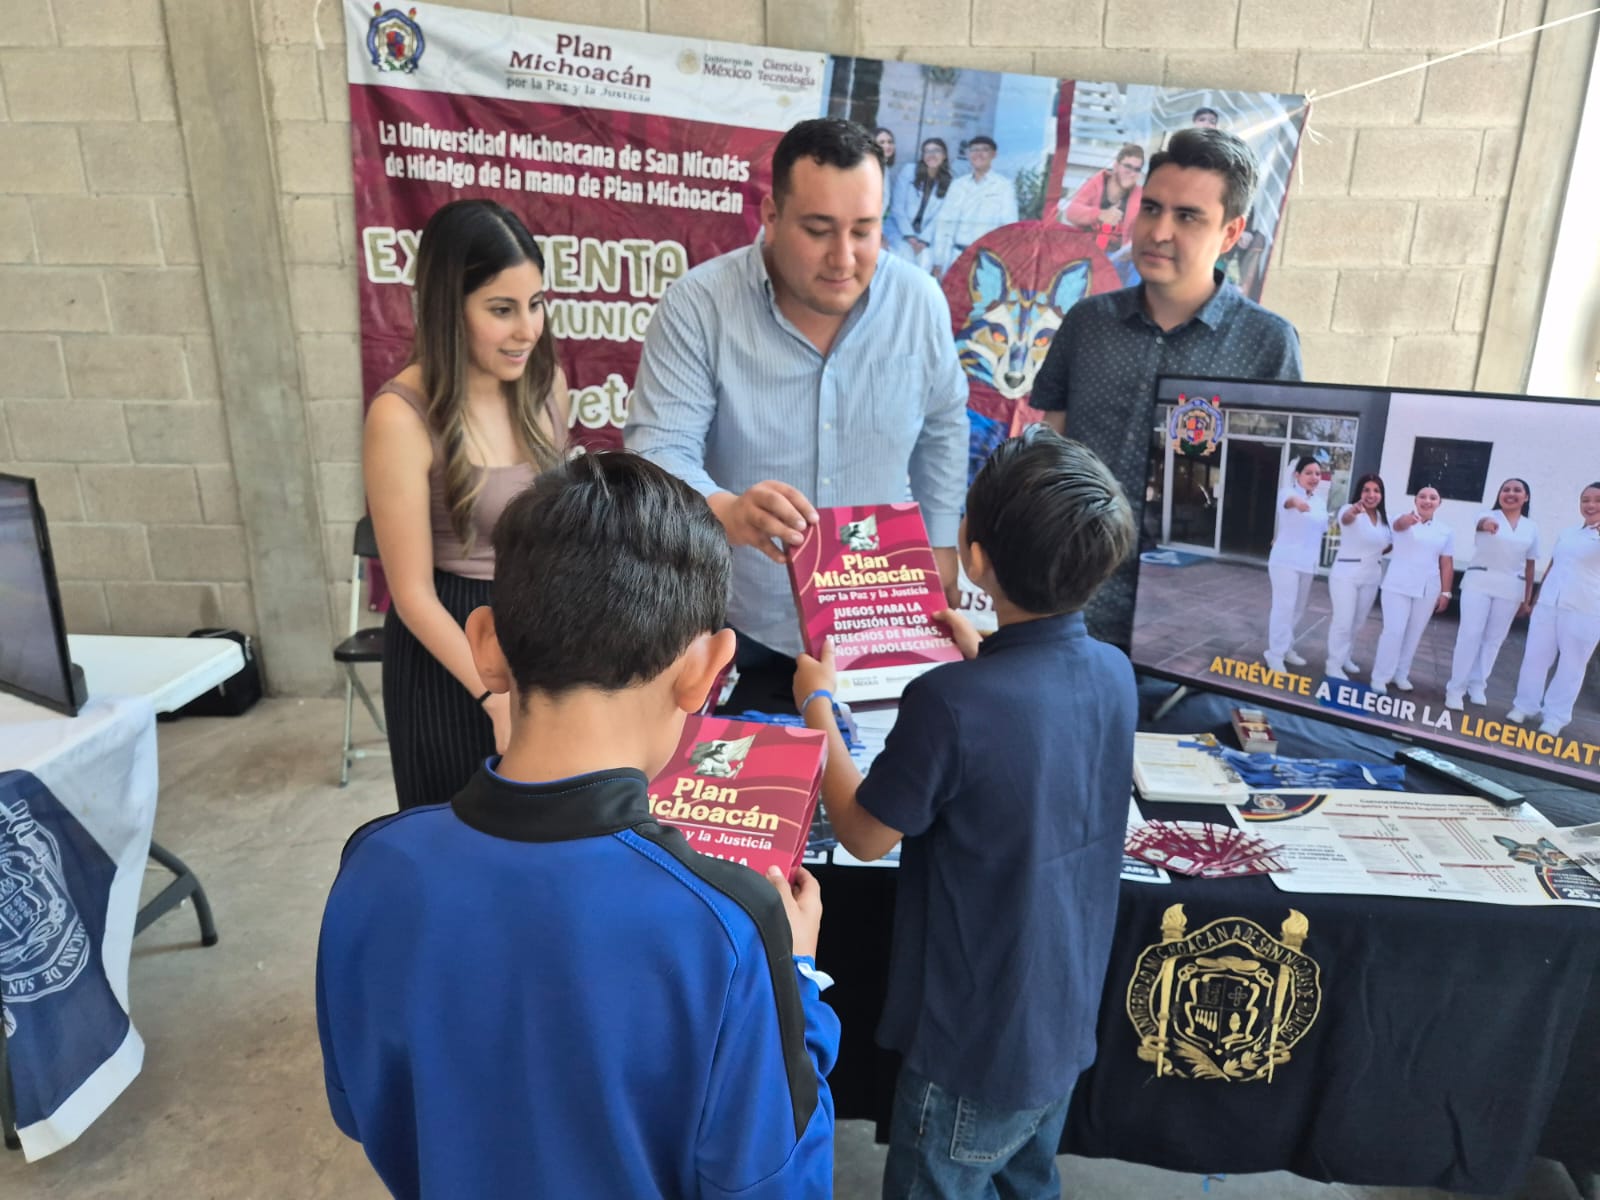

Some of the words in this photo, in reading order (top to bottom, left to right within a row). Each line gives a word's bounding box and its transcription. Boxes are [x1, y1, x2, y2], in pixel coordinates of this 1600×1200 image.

[556, 33, 612, 61] Plan
[509, 50, 651, 89] Michoacán
[703, 63, 752, 80] México
[762, 58, 803, 72] Ciencia
[804, 64, 812, 75] y
[757, 70, 816, 86] Tecnología
[506, 76, 527, 89] por
[531, 77, 542, 90] la
[547, 79, 568, 92] Paz
[572, 84, 581, 95] y
[585, 84, 596, 95] la
[600, 86, 651, 102] Justicia
[378, 120, 397, 145] La
[399, 121, 506, 157] Universidad
[510, 133, 615, 168] Michoacana
[618, 144, 642, 171] de
[645, 147, 678, 175] San
[682, 150, 750, 182] Nicolás
[385, 151, 405, 177] de
[406, 154, 475, 189] Hidalgo
[478, 160, 501, 188] de
[504, 163, 521, 190] la
[524, 169, 575, 197] mano
[578, 172, 600, 198] de
[604, 175, 643, 203] Plan
[647, 180, 744, 214] Michoacán
[841, 553, 889, 570] Plan
[813, 564, 925, 588] Michoacán
[818, 594, 836, 604] por
[838, 591, 848, 601] la
[850, 591, 868, 601] Paz
[869, 591, 877, 601] y
[878, 589, 889, 598] la
[891, 586, 929, 598] Justicia
[834, 605, 875, 619] JUEGOS
[876, 603, 906, 615] PARA
[907, 602, 923, 612] LA
[834, 616, 888, 630] DIFUSIÓN
[890, 616, 905, 627] DE
[906, 614, 928, 625] LOS
[826, 631, 884, 644] DERECHOS
[886, 629, 901, 640] DE
[860, 644, 869, 655] Y
[871, 638, 953, 655] ADOLESCENTES
[1210, 656, 1312, 696] ATRÉVETE
[1315, 681, 1331, 701] A
[1337, 685, 1416, 722] ELEGIR
[1421, 705, 1453, 731] LA
[1460, 714, 1600, 766] LICENCIAT
[672, 777, 738, 804] Plan
[648, 794, 780, 831] ichoacán
[685, 831, 695, 841] y
[697, 830, 712, 842] la
[715, 832, 772, 850] Justicia
[1256, 937, 1285, 961] SAN
[41, 966, 63, 985] DE
[8, 977, 36, 995] SAN
